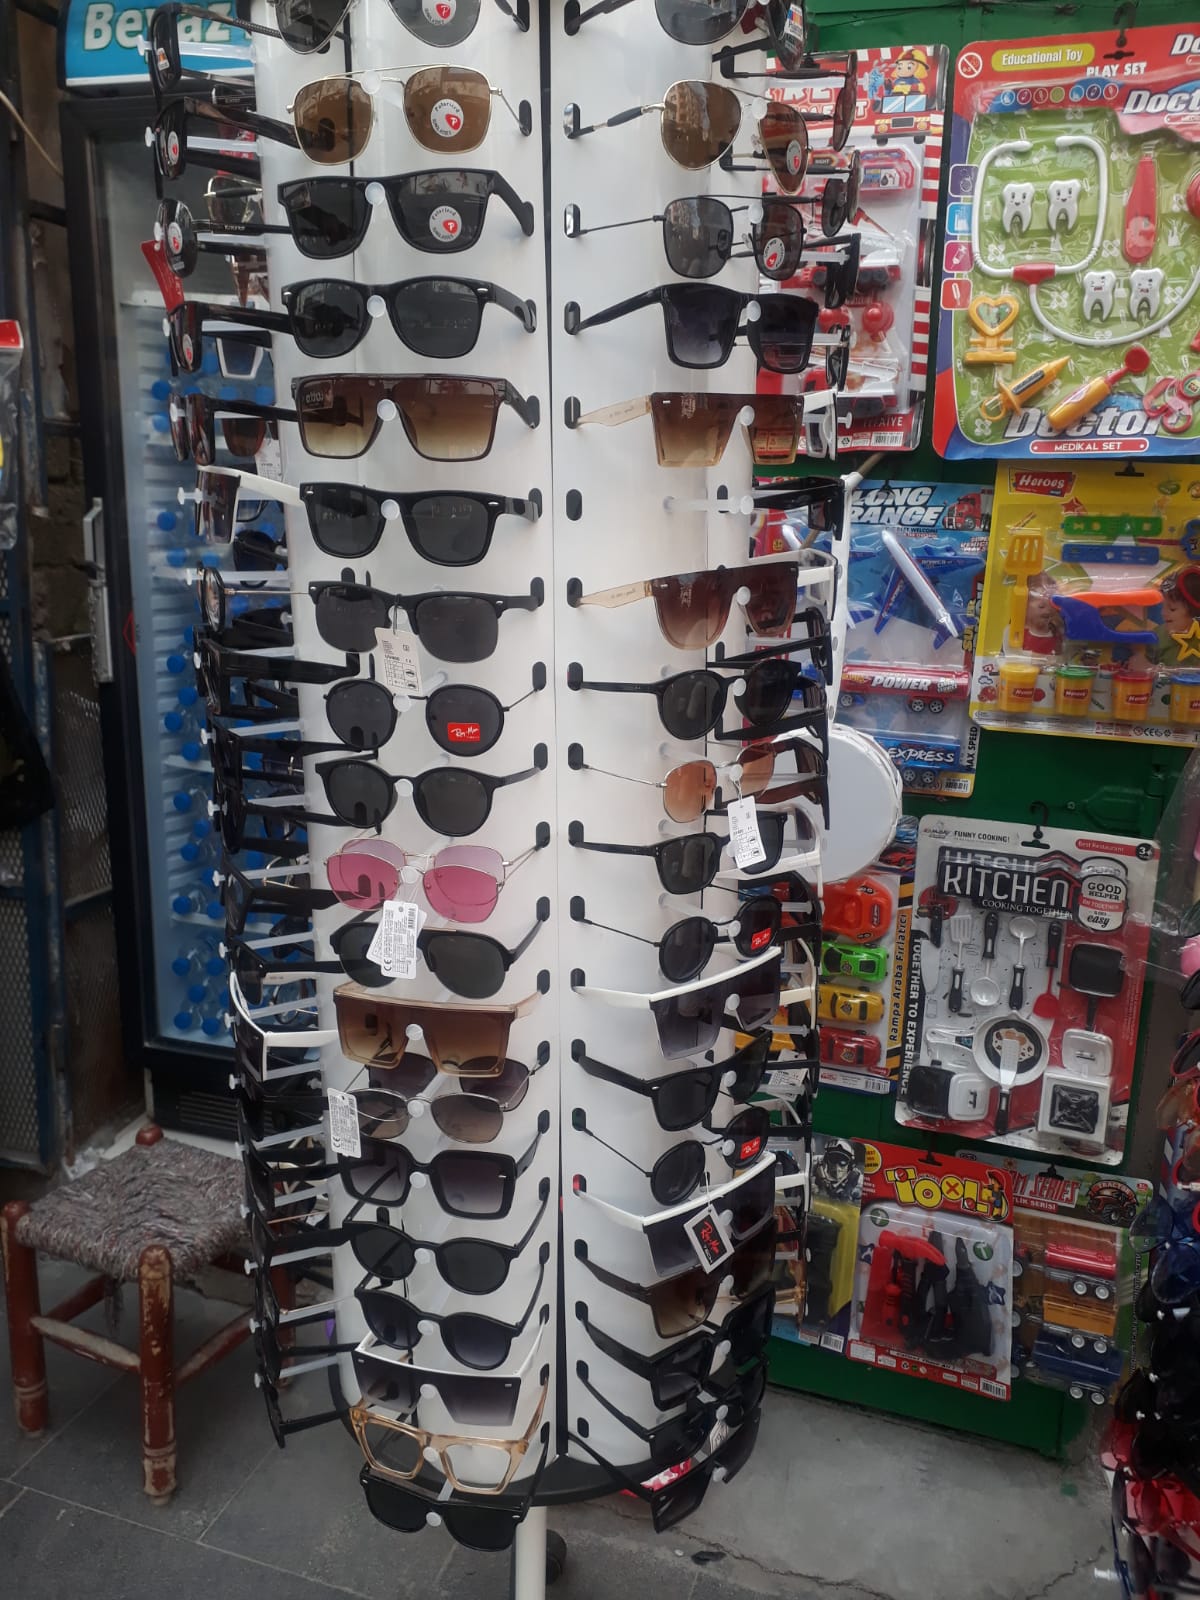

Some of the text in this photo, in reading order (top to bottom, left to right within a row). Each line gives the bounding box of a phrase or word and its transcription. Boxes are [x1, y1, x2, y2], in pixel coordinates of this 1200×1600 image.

[1002, 49, 1083, 66] Educational Toy
[1086, 61, 1147, 77] PLAY SET
[1102, 441, 1122, 451] SET
[1018, 474, 1065, 489] Heroes
[852, 485, 932, 507] LONG
[850, 505, 943, 527] RANGE
[871, 675, 932, 691] POWER
[967, 726, 978, 751] SPEED
[887, 747, 954, 763] EXPRESS
[954, 830, 977, 839] FUNNY
[977, 832, 1010, 843] COOKING!
[1079, 840, 1091, 848] Best
[943, 864, 1069, 908] KITCHEN
[1087, 882, 1122, 895] GOOD
[1089, 891, 1120, 900] HELPER
[982, 899, 1023, 912] COOKING
[1087, 914, 1110, 928] easy
[910, 937, 922, 1000] TOGETHER
[892, 965, 903, 1000] Araba
[908, 1003, 918, 1018] TO
[889, 1002, 901, 1042] Rampa
[885, 1168, 989, 1214] TOOL
